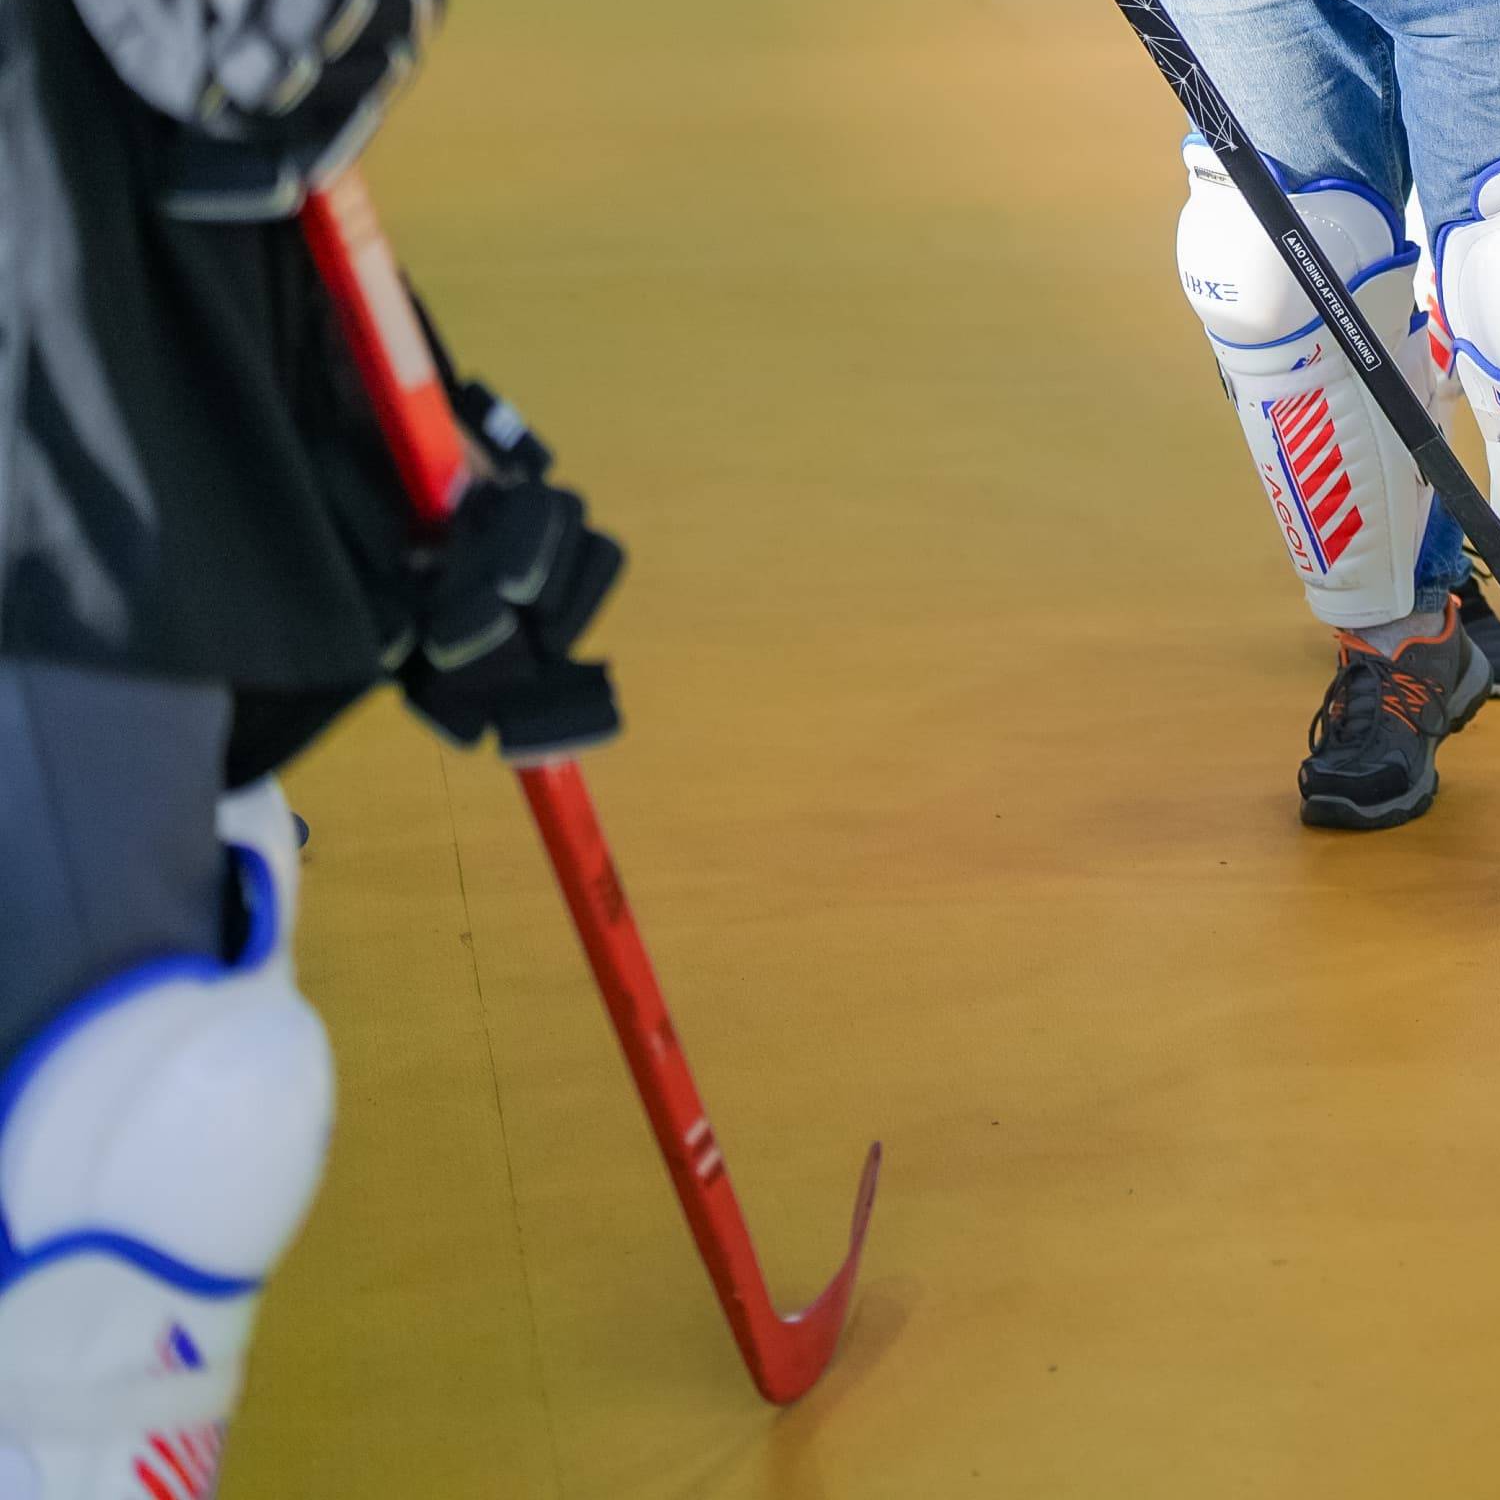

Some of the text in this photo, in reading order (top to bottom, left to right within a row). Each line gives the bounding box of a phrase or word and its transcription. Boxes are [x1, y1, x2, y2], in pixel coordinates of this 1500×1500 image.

[1292, 243, 1374, 364] NO USING AFTER BREAKING
